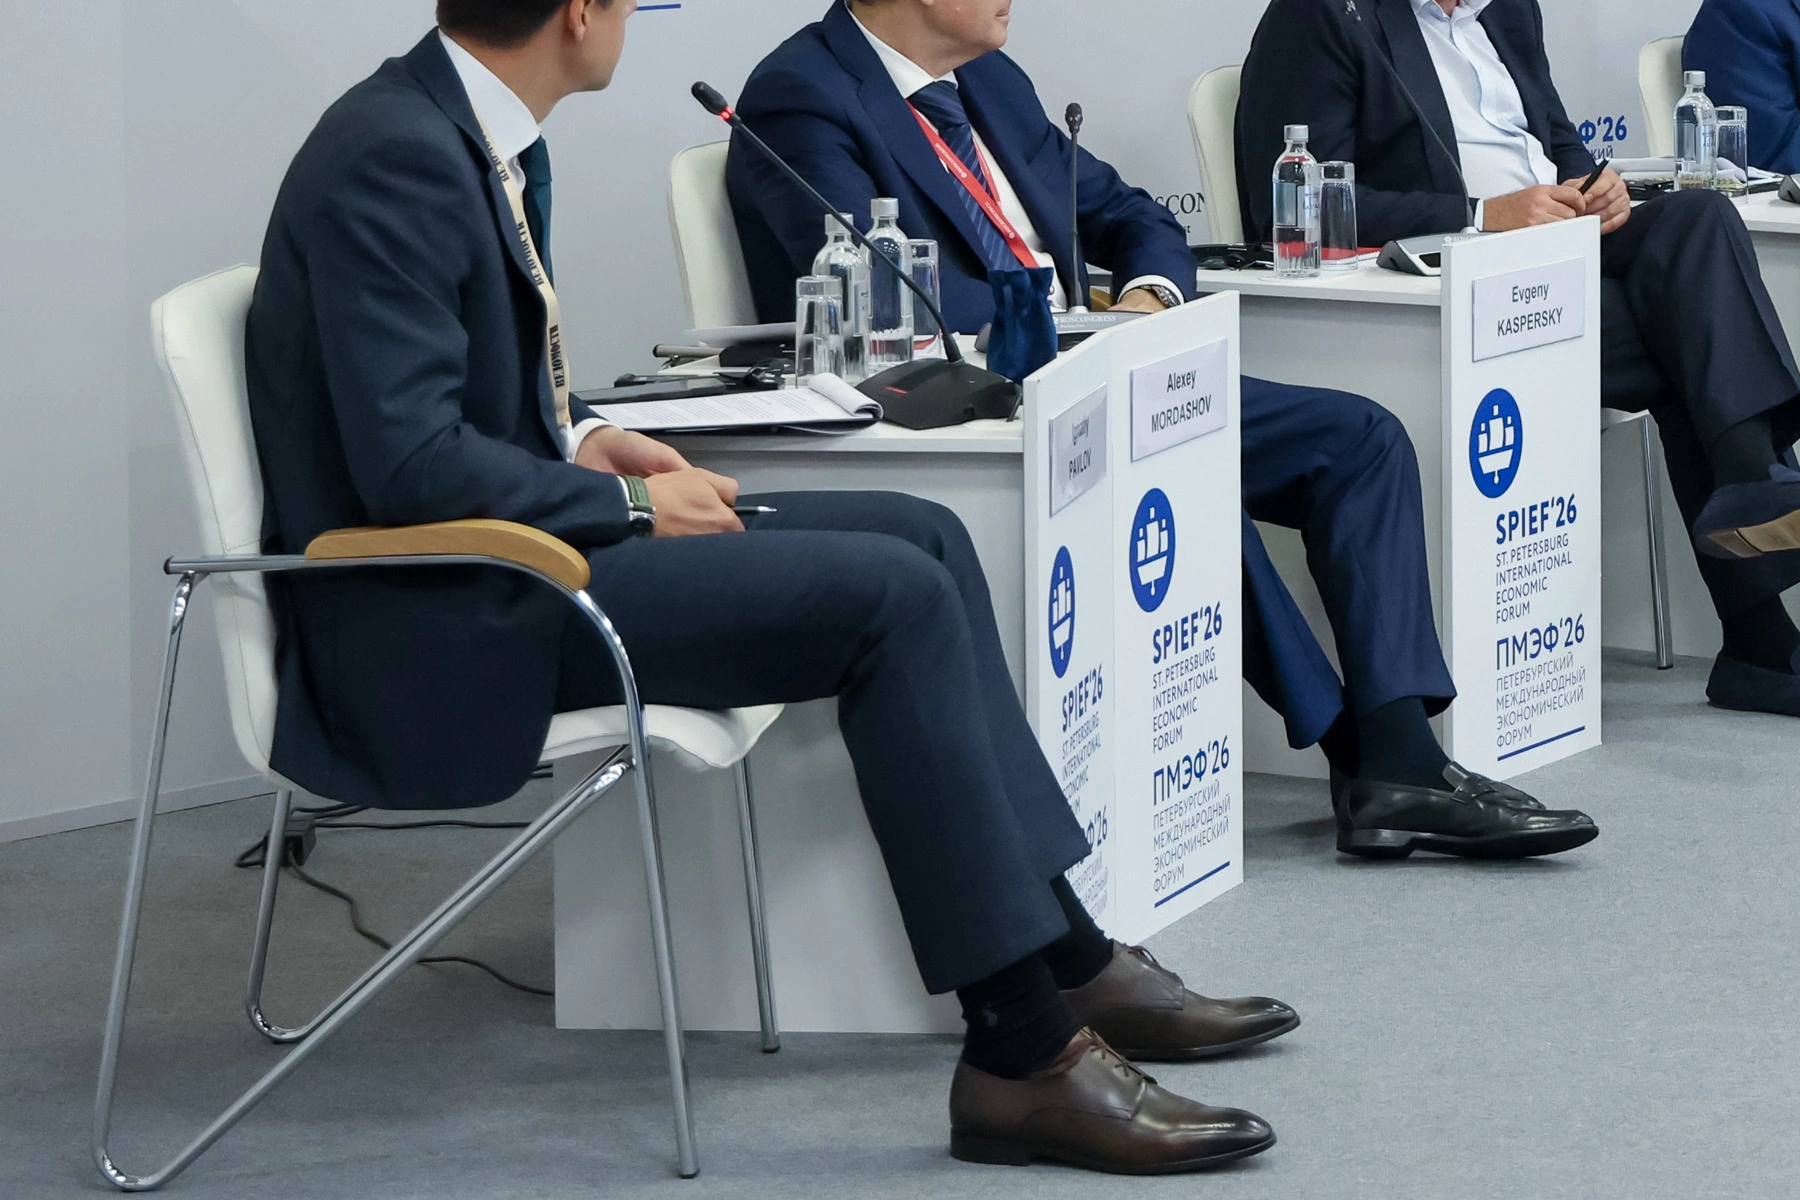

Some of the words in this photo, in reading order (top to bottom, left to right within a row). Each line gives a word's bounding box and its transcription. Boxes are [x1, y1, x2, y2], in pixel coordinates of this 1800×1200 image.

[1512, 283, 1549, 305] Evgeny
[1498, 307, 1563, 337] KASPERSKY
[549, 324, 565, 388] ВЕДОМОСТИ
[1167, 370, 1196, 393] Alexey
[1151, 395, 1211, 433] MORDASHOV
[1069, 447, 1091, 480] PAVLOV
[1496, 552, 1509, 568] ST.
[1511, 533, 1568, 564] PETERSBURG
[1496, 551, 1572, 587] INTERNATIONAL
[1496, 576, 1548, 606] ECONOMIC
[1496, 601, 1530, 625] FORUM
[1153, 671, 1163, 689] ST.
[1166, 646, 1215, 682] PETERSBURG
[1496, 651, 1574, 693] ПЕТЕРБУРГСКИЙ
[1153, 674, 1218, 711] INTERNATIONAL
[1496, 665, 1586, 712] МЕЖДУНАРОДНЫЙ
[1153, 697, 1197, 732] ECONOMIC
[1496, 686, 1584, 731] ЭКОНОМИЧЕСКИЙ
[1153, 728, 1182, 754] FORUM
[1497, 723, 1532, 749] ФОРУМ
[1153, 779, 1220, 830] ПЕТЕРБУРГСКИЙ
[1153, 794, 1230, 852] МЕЖДУНАРОДНЫЙ
[1153, 817, 1229, 873] ЭКОНОМИЧЕСКИЙ
[1153, 867, 1184, 894] ФОРУМ
